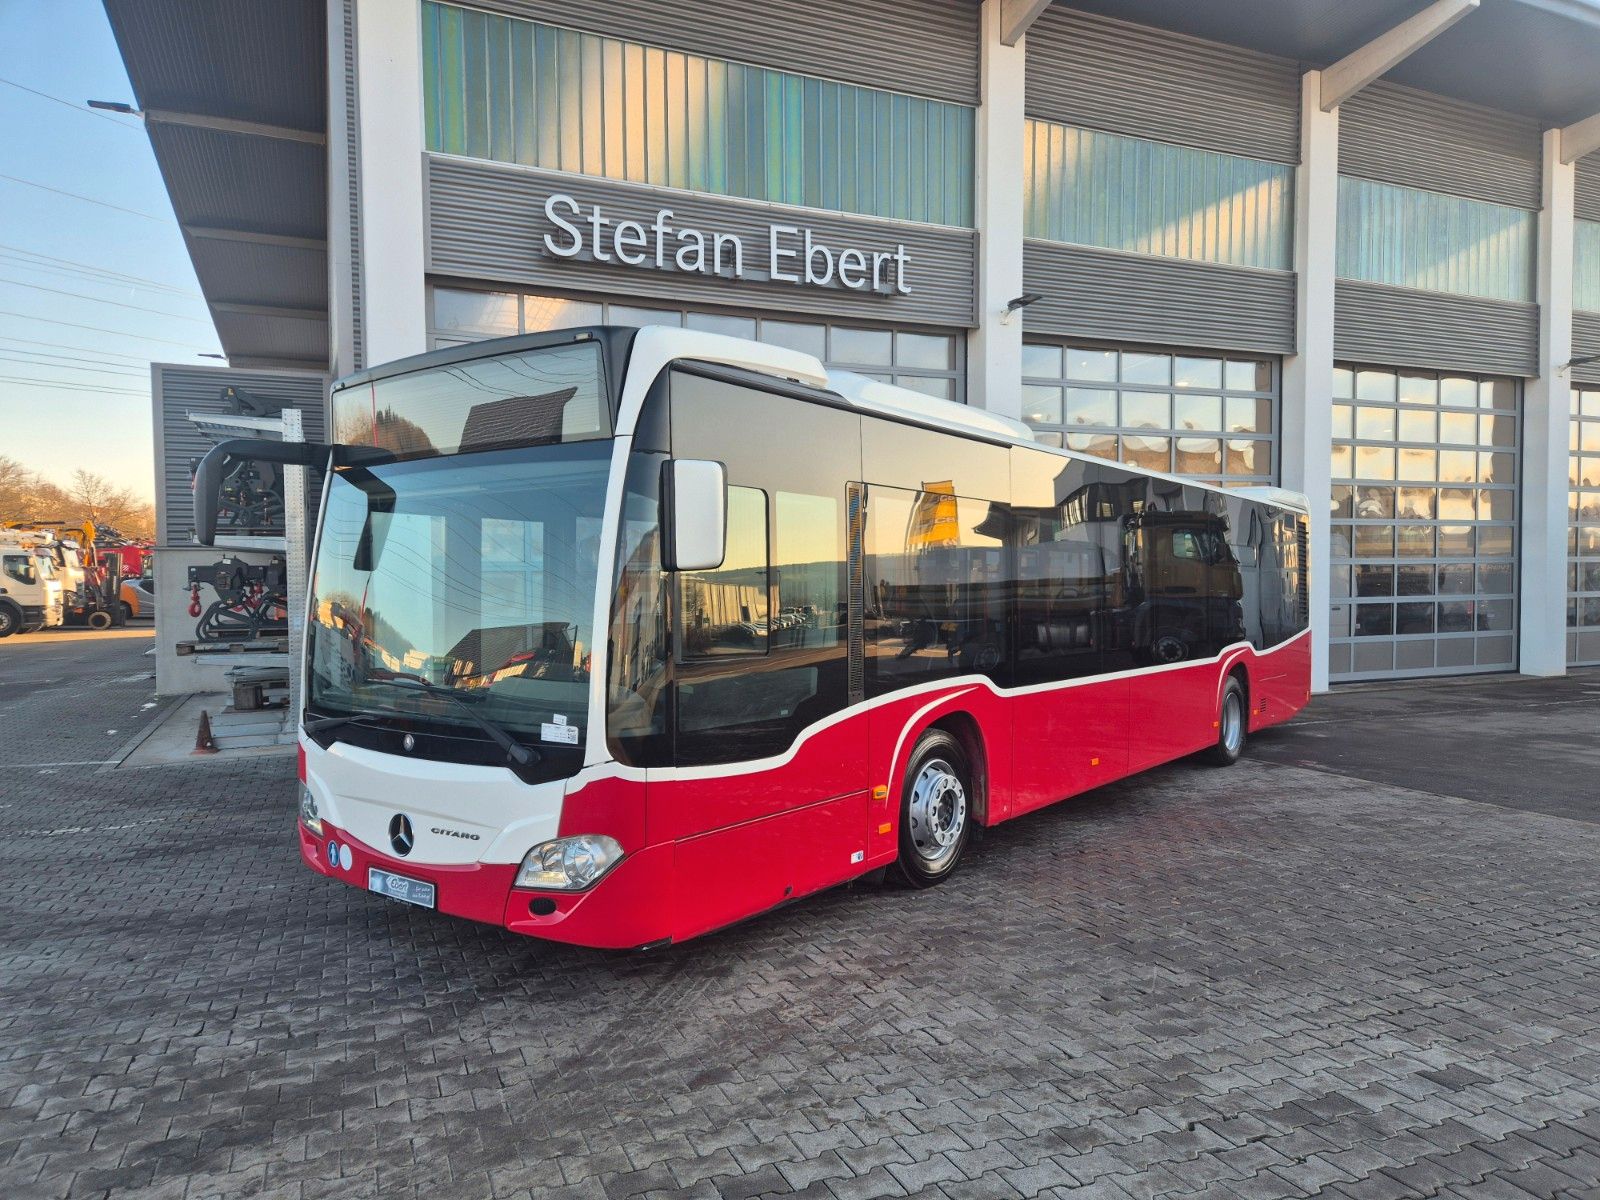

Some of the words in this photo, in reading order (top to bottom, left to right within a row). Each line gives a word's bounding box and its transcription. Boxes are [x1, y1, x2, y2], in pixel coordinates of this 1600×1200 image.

[543, 194, 743, 276] Stefan
[769, 224, 912, 294] Ebert
[431, 827, 480, 841] CITARO
